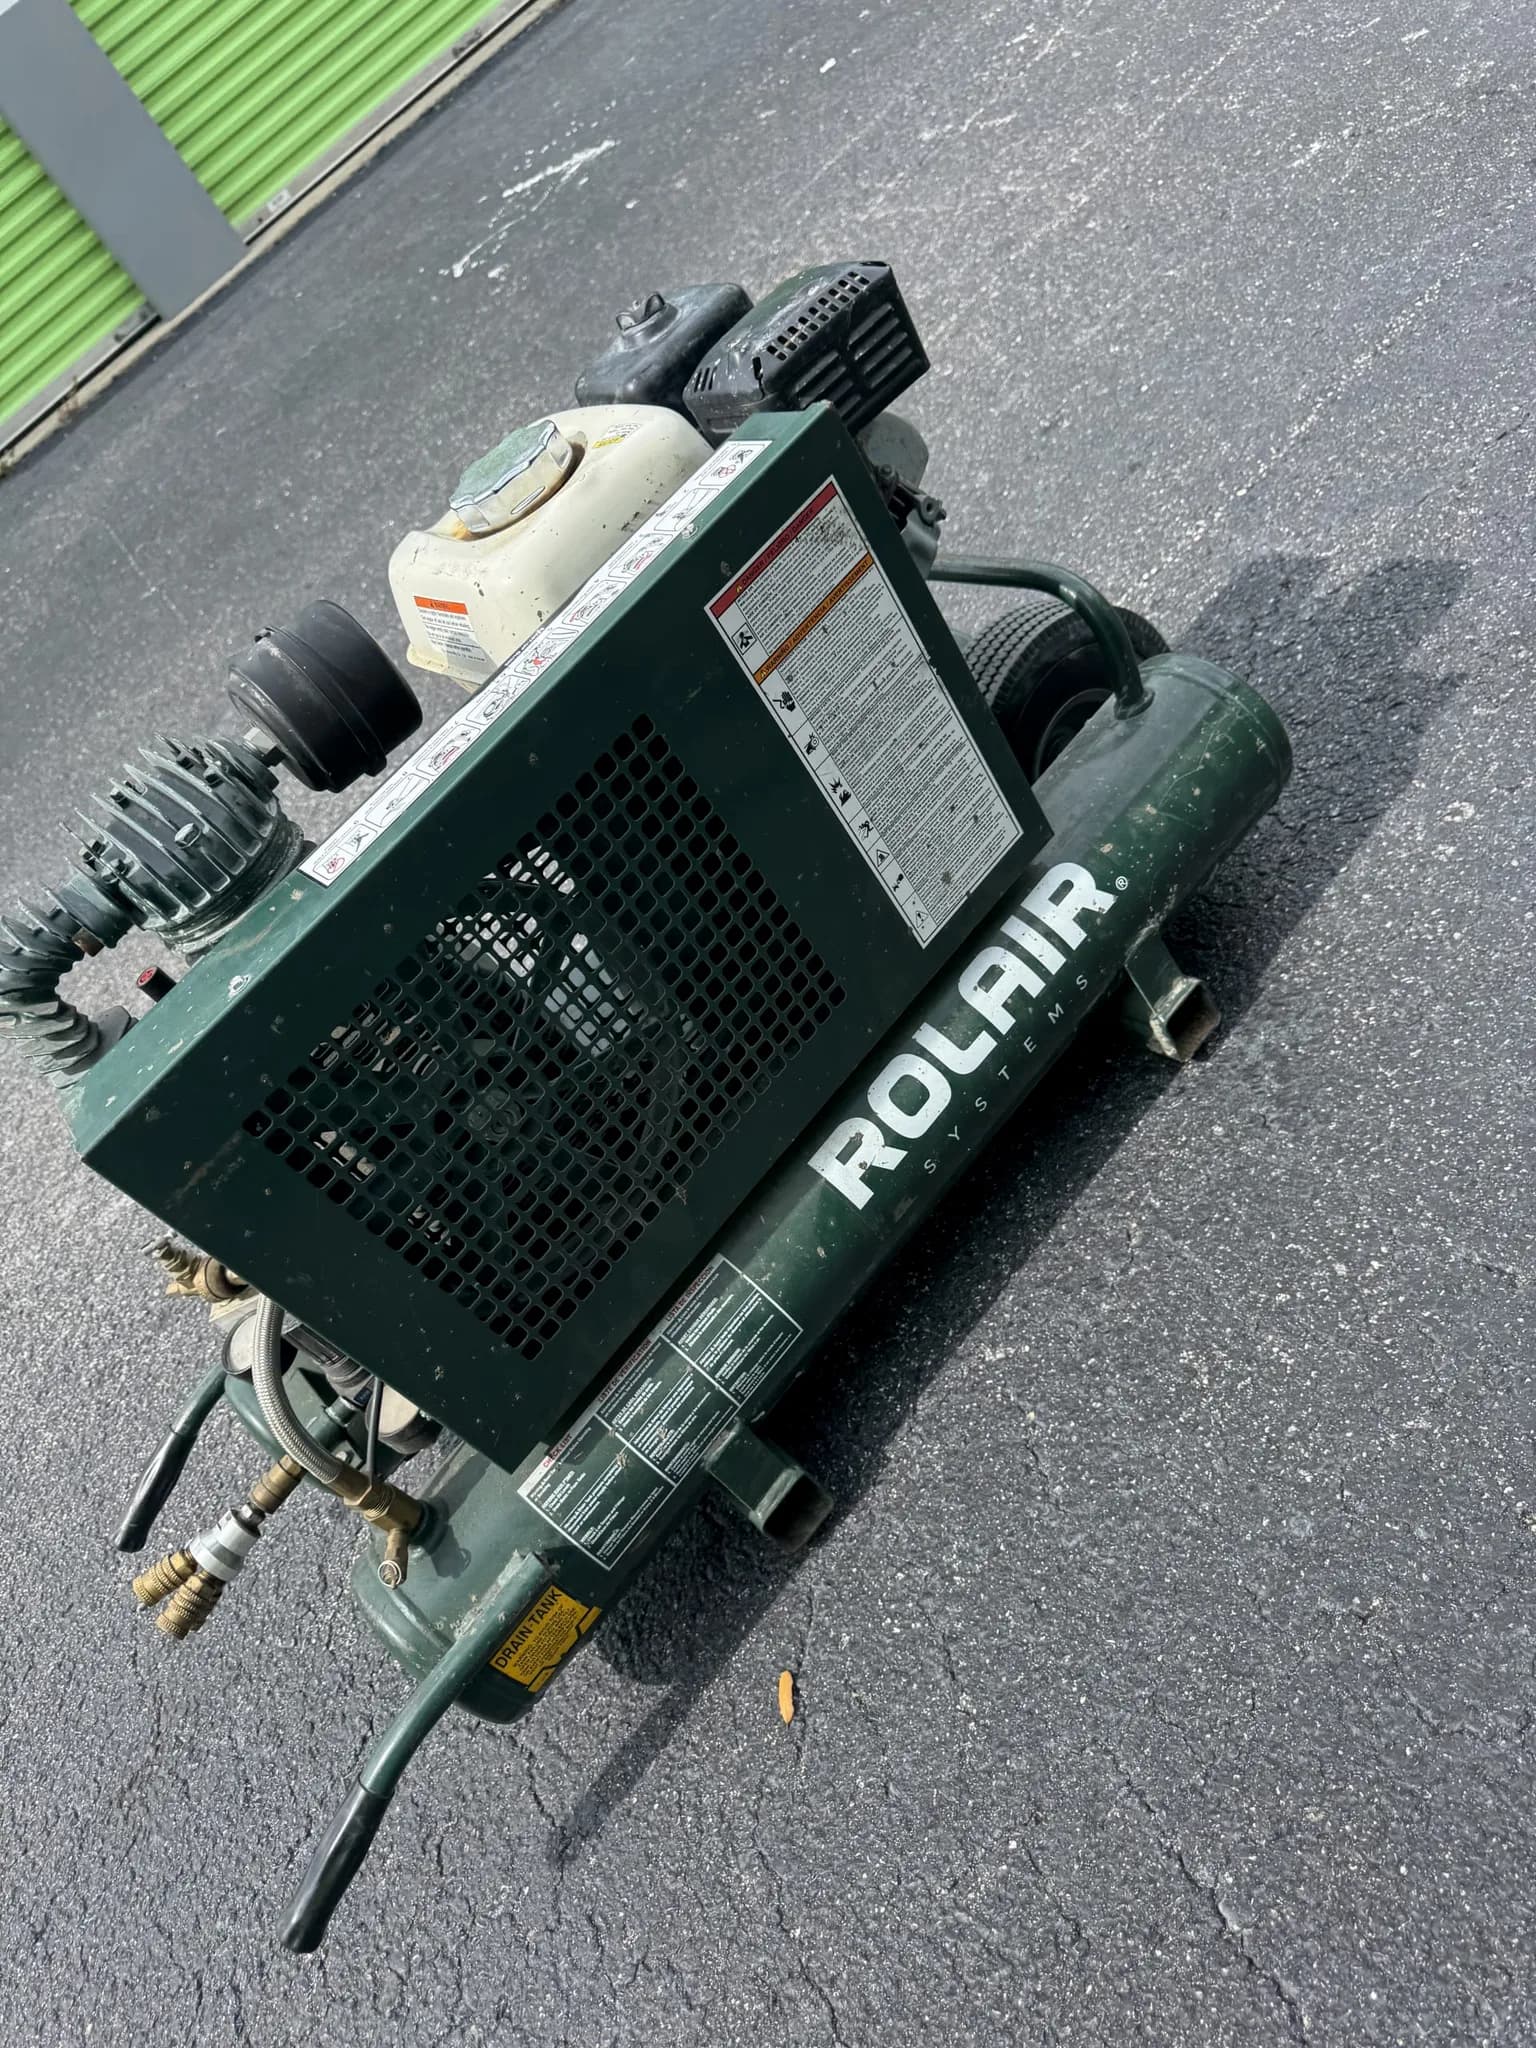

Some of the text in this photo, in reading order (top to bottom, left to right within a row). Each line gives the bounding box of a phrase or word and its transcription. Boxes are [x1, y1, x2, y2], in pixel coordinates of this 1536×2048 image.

[808, 862, 1117, 1209] ROLAIR
[922, 976, 1089, 1173] SYSTEMS
[493, 1625, 533, 1669] DRAIN
[527, 1589, 562, 1626] TANK
